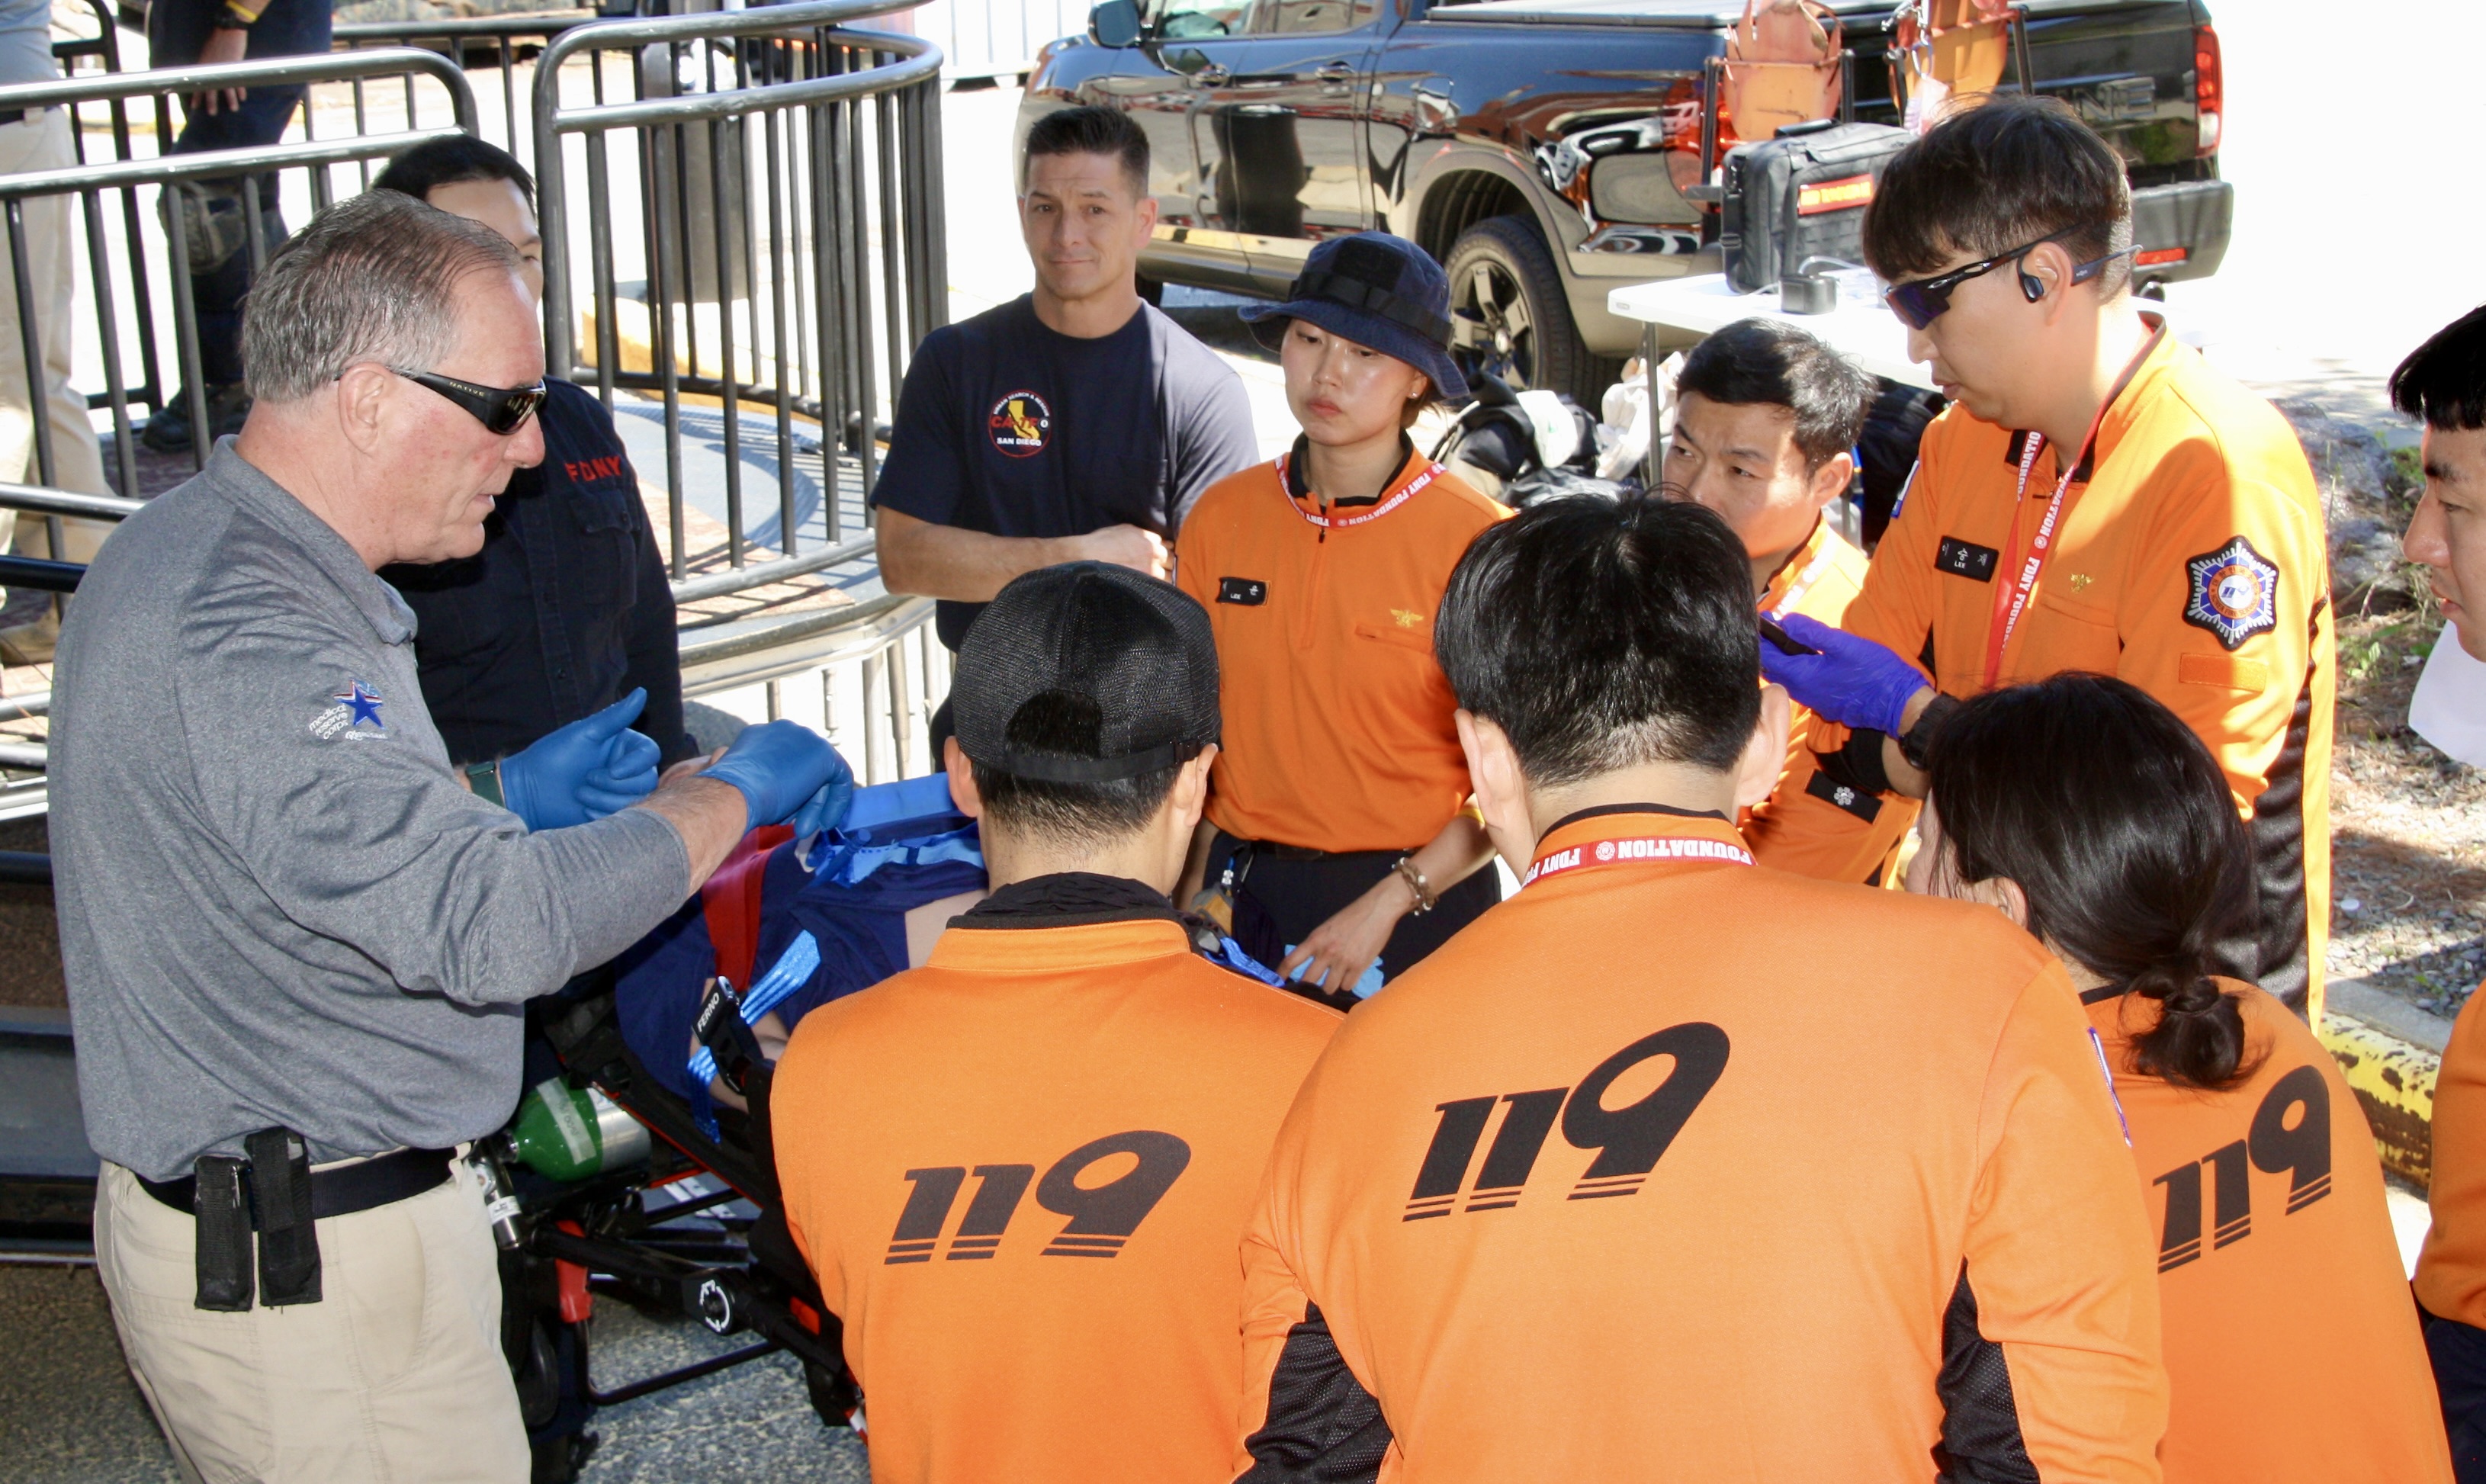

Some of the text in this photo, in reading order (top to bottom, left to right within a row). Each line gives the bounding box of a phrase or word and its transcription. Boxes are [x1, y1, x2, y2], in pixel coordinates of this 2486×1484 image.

[449, 382, 485, 397] NATIVE
[1016, 438, 1042, 446] DIEGO
[564, 456, 622, 483] FDNY
[1347, 490, 1410, 525] FOUNDATION
[1954, 560, 1967, 570] LEE
[2019, 557, 2041, 592] FDNY
[315, 712, 348, 737] reserve
[323, 720, 348, 740] corps
[1540, 848, 1582, 875] FDNY
[1617, 840, 1753, 866] FOUNDATION
[697, 992, 720, 1033] FERNO
[1402, 1021, 1730, 1222] 119
[2153, 1065, 2331, 1274] 119
[884, 1129, 1191, 1264] 119
